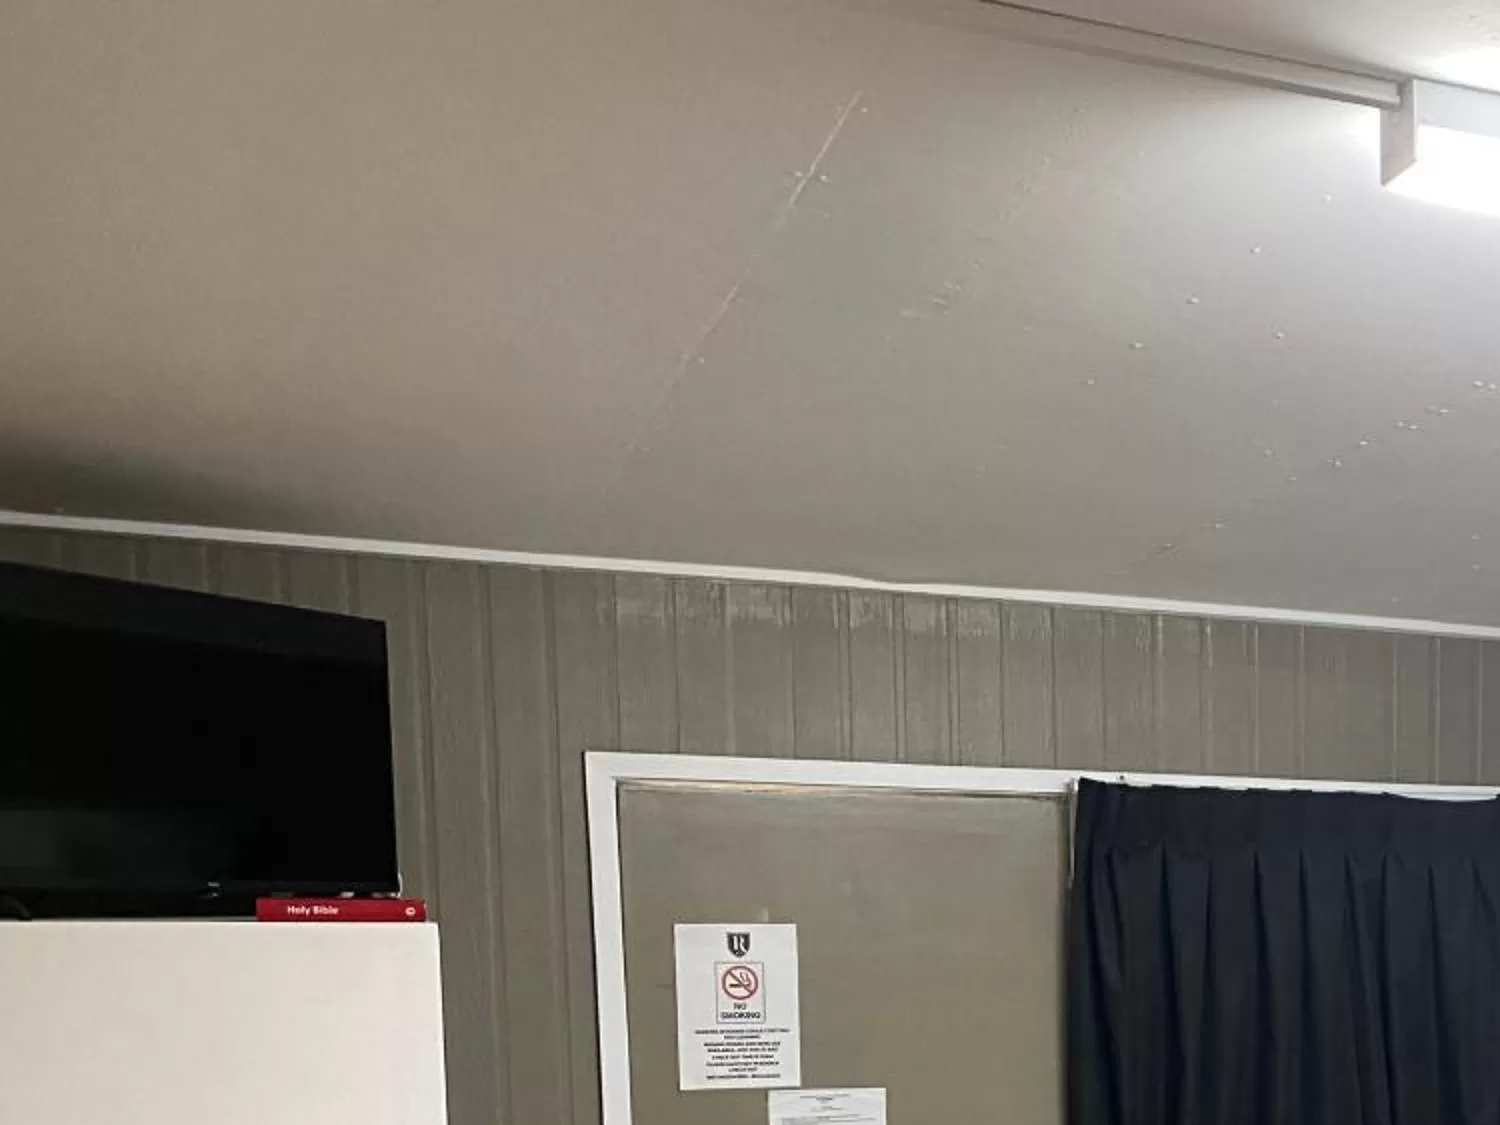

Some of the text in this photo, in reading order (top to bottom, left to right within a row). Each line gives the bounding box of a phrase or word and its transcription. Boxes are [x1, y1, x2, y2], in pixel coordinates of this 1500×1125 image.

[287, 905, 339, 916] Holy Bible
[733, 1002, 747, 1010] NO
[720, 1011, 761, 1019] SMOKING
